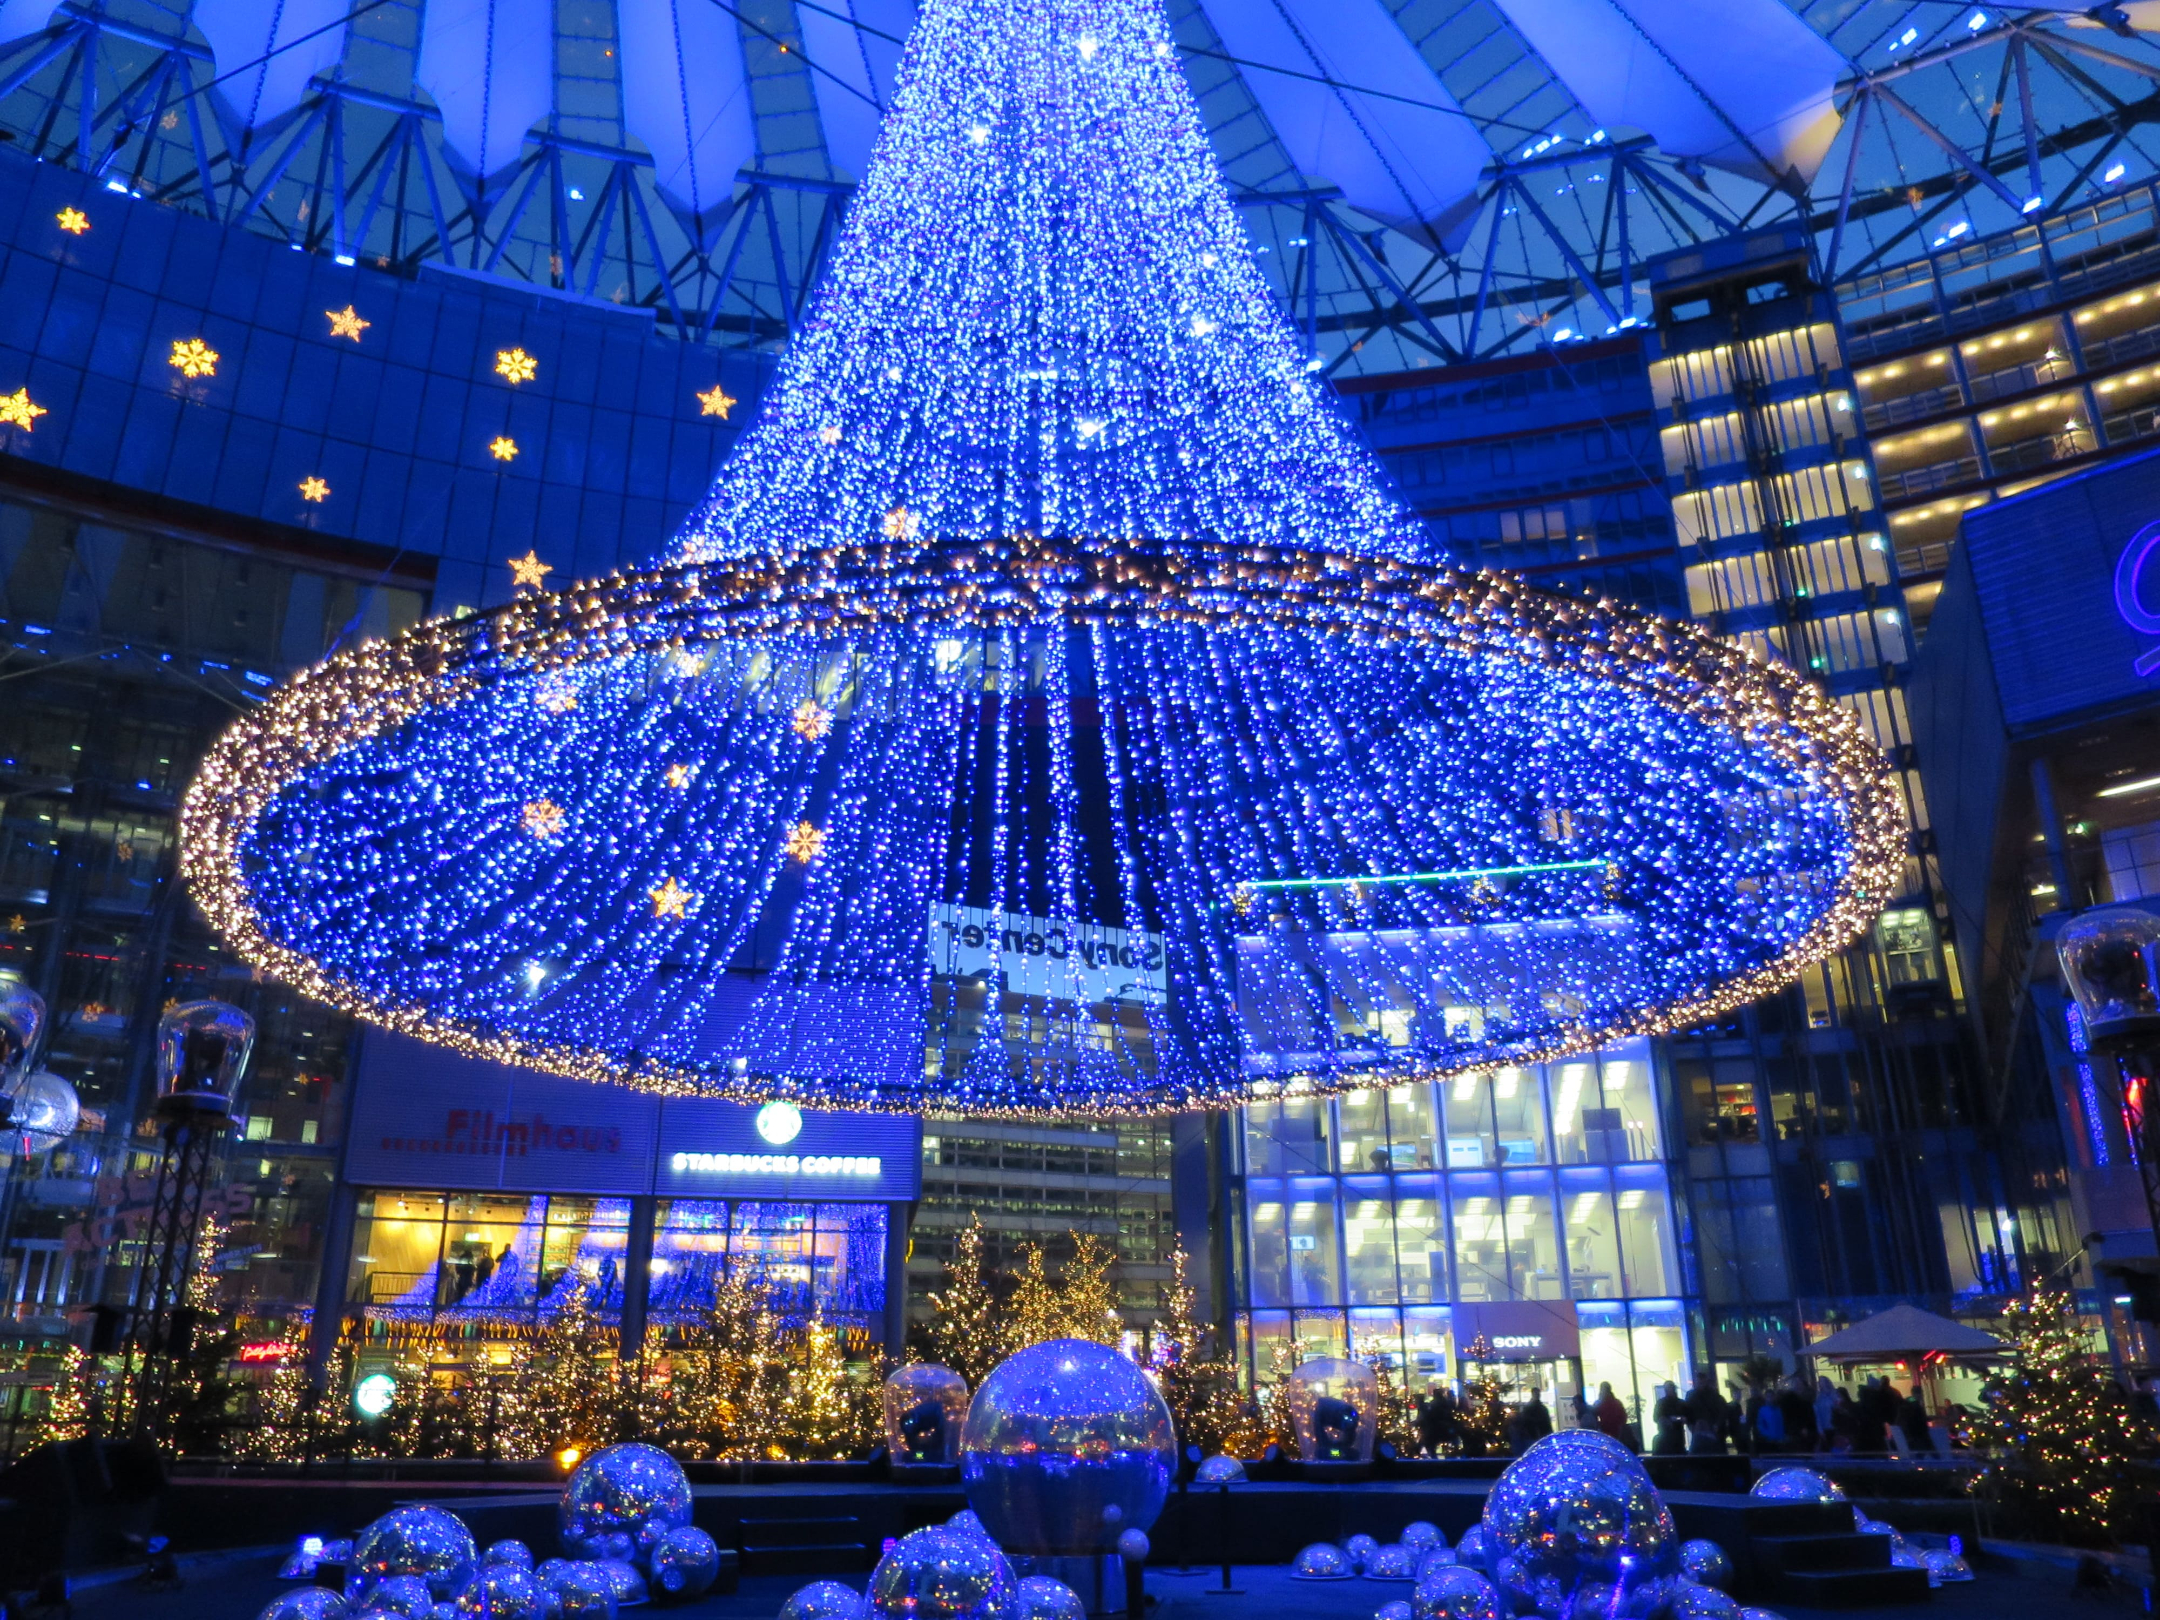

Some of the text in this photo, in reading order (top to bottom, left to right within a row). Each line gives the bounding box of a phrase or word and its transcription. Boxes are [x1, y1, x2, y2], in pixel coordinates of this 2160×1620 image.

[446, 1109, 622, 1153] Filmhaus
[672, 1152, 882, 1175] STARBUCKS COFFEE
[1492, 1335, 1542, 1349] SONY
